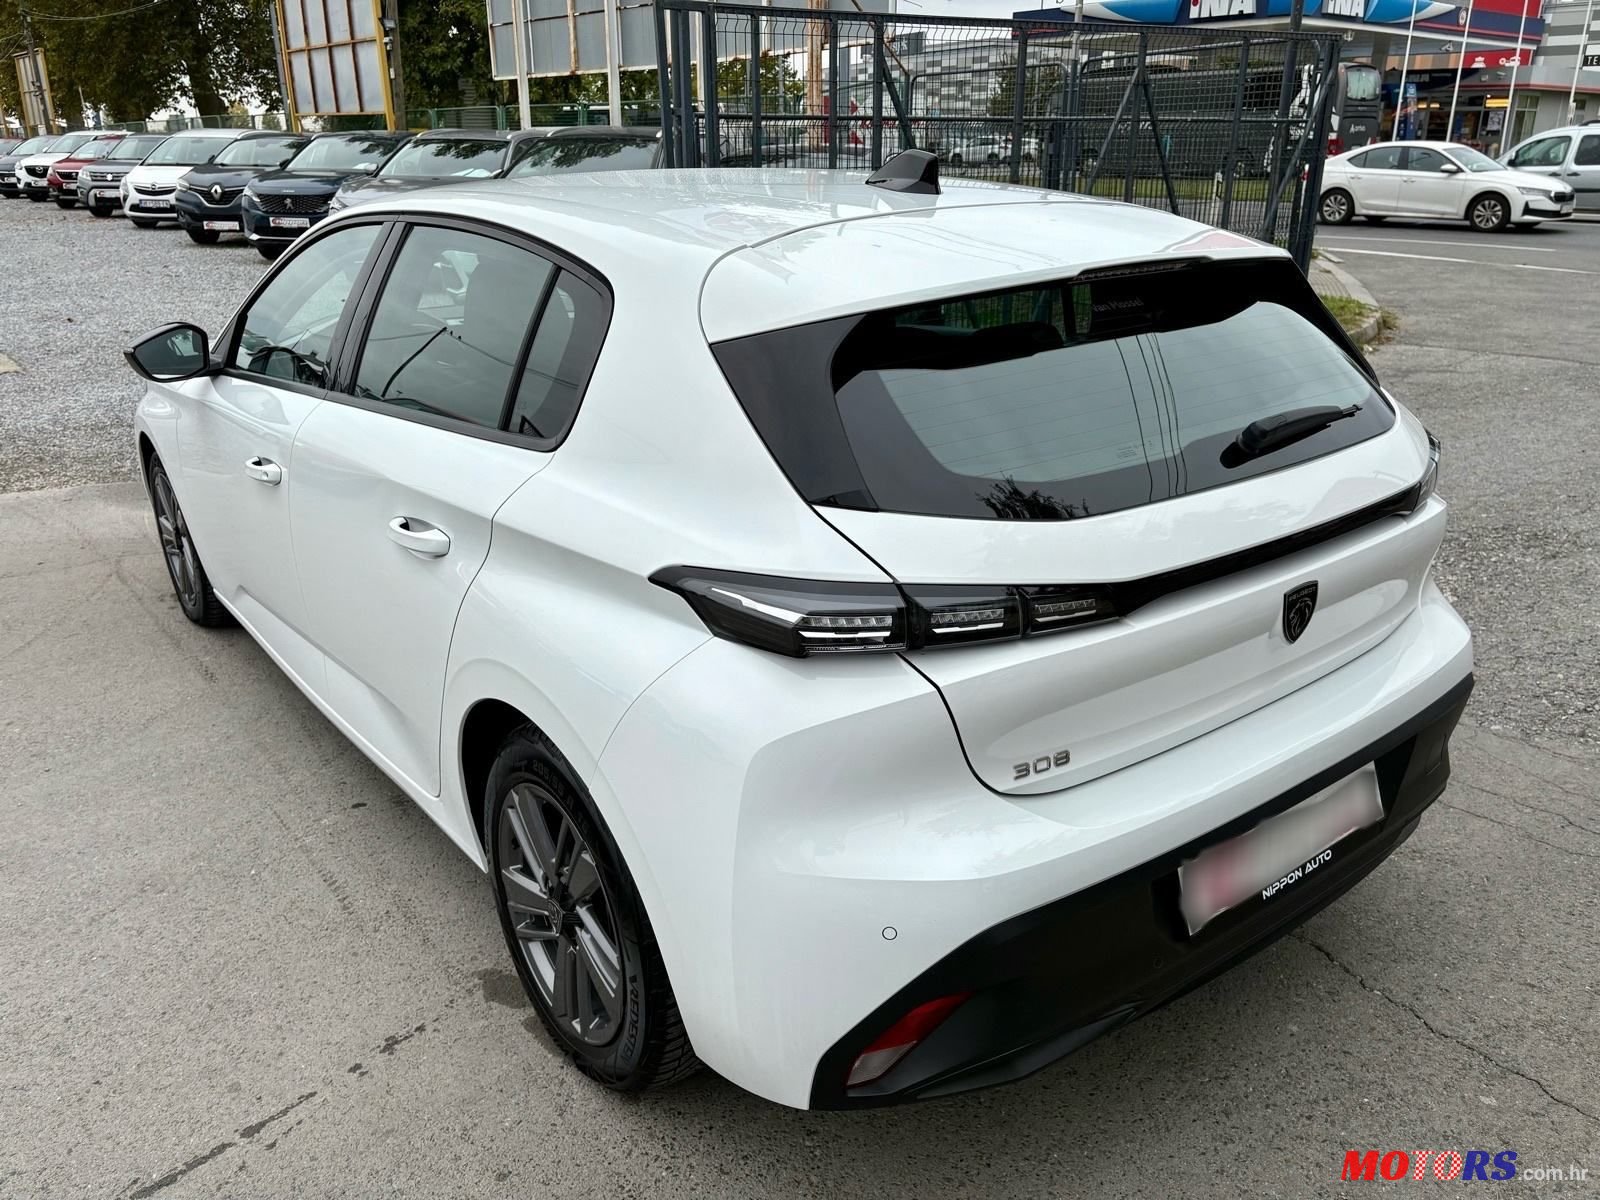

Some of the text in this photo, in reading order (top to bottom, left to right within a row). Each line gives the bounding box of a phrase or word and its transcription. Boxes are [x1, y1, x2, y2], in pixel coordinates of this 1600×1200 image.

[1013, 750, 1070, 781] 308
[1262, 849, 1333, 900] NIPPON AUTO
